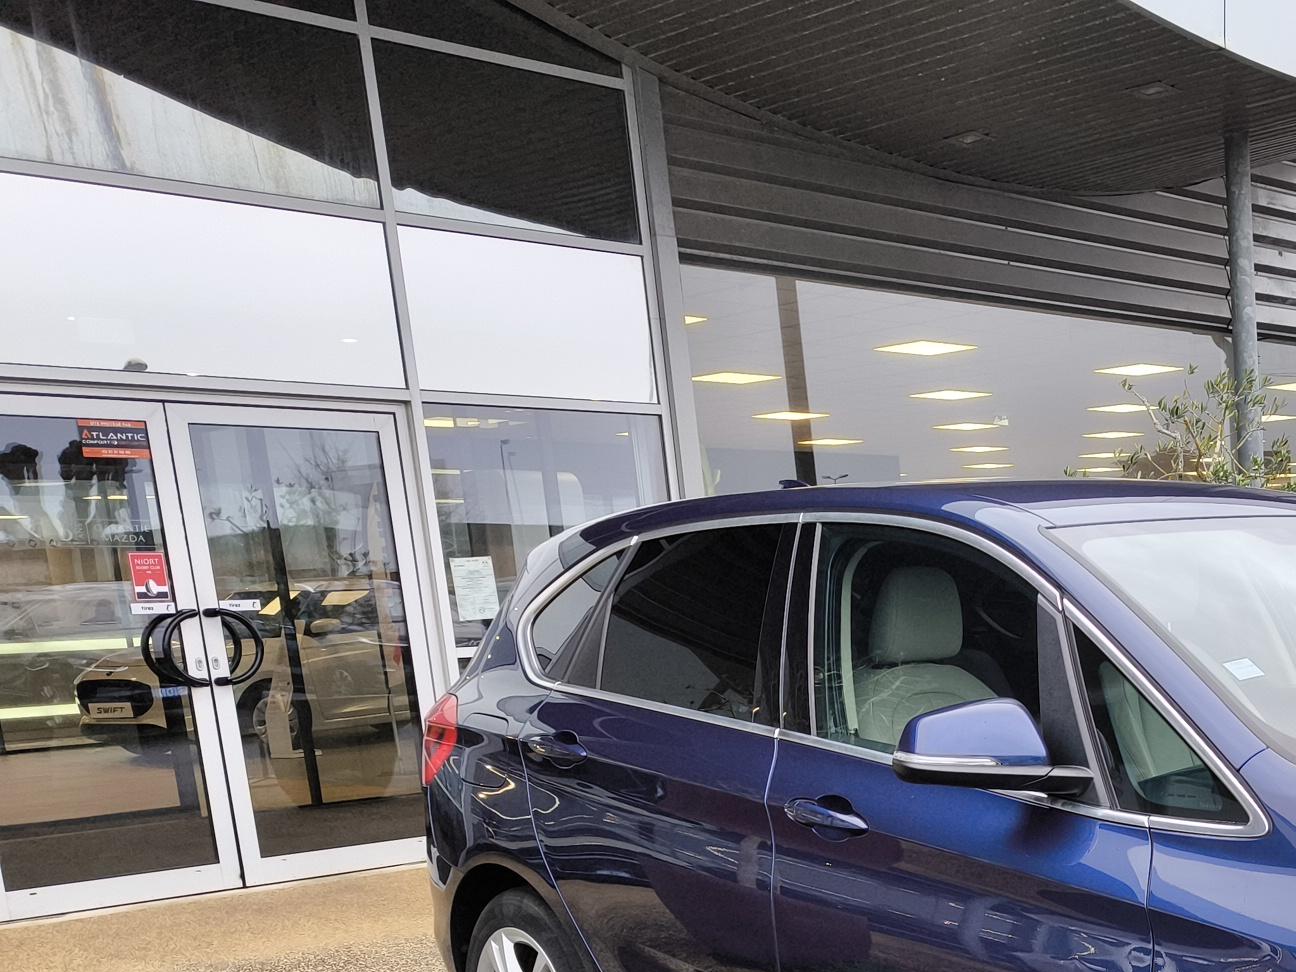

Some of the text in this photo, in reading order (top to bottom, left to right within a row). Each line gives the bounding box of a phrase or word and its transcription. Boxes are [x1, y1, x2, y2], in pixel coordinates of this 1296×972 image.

[82, 429, 146, 441] ATLANTIC
[134, 558, 159, 566] NIORT
[96, 706, 126, 715] SWIFT
